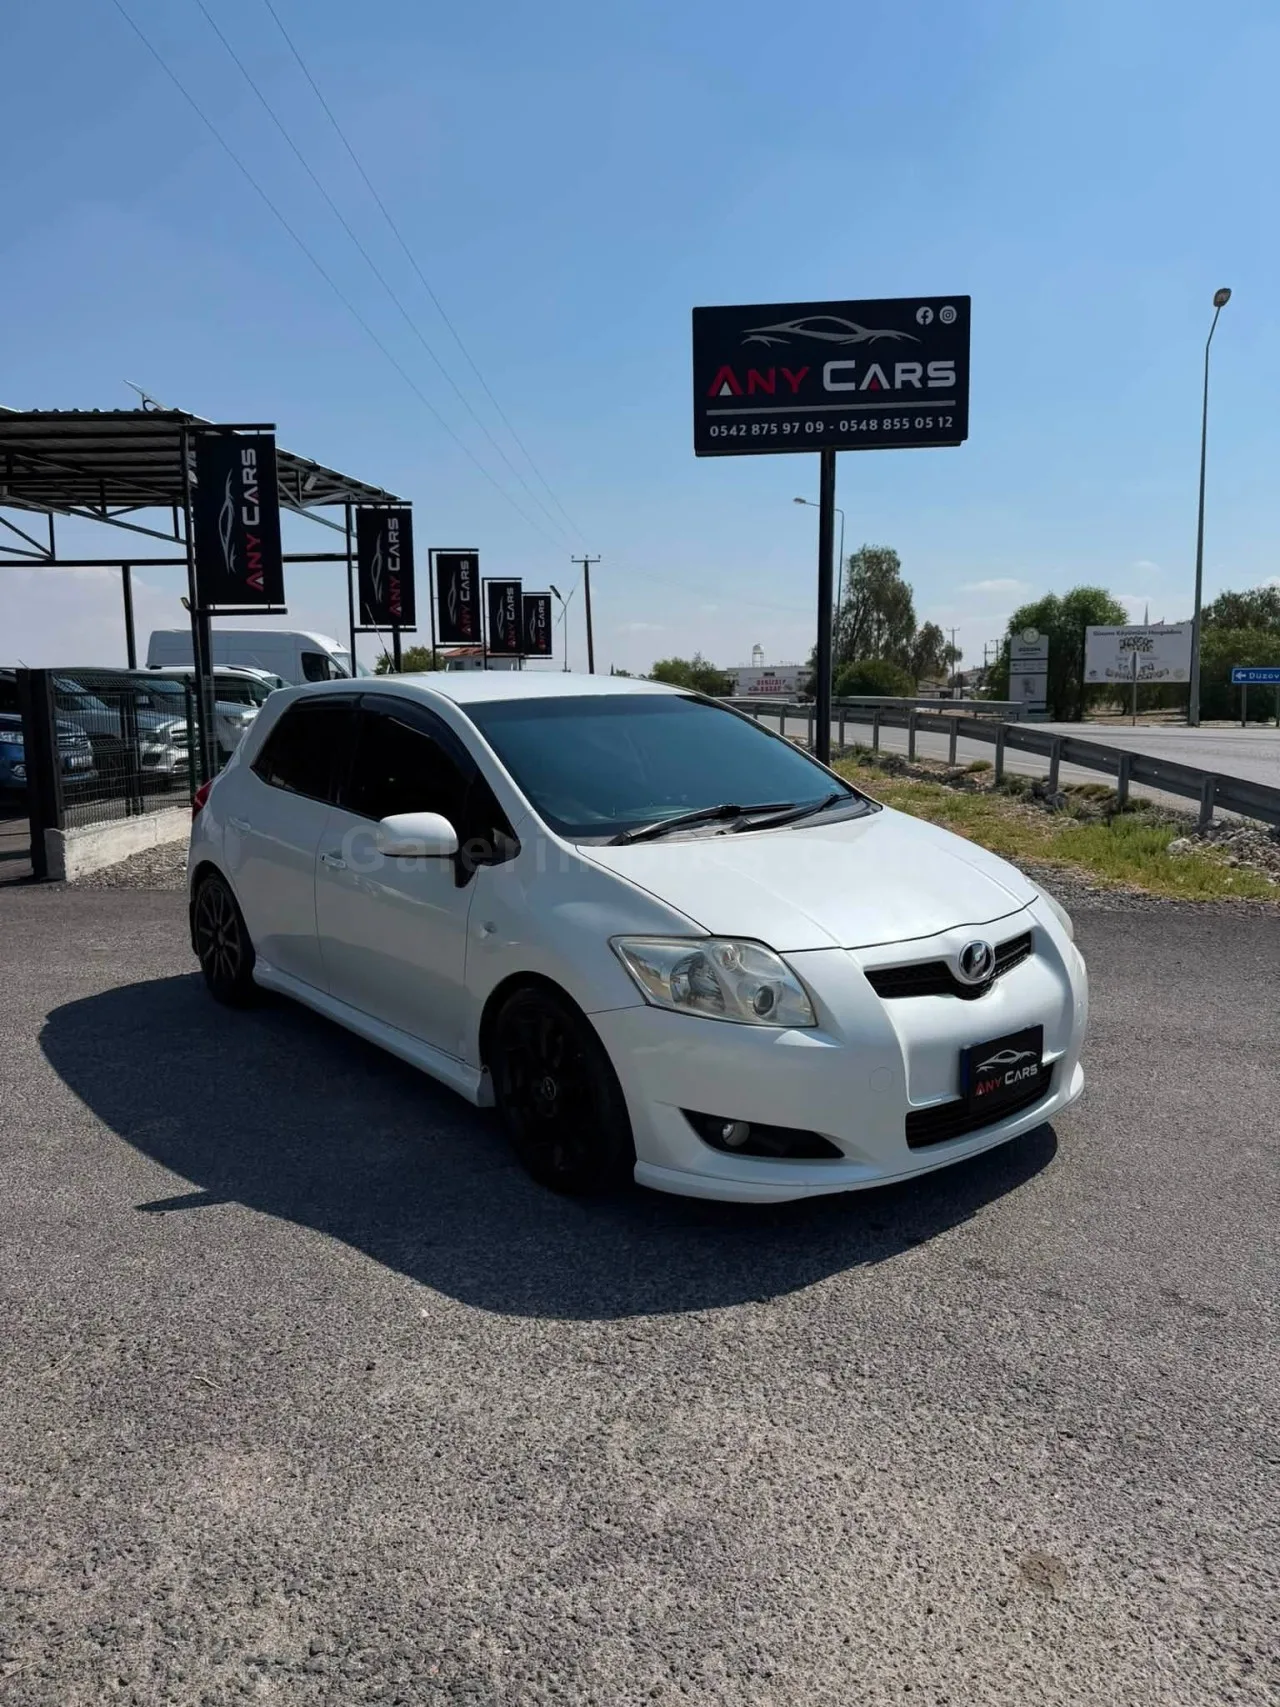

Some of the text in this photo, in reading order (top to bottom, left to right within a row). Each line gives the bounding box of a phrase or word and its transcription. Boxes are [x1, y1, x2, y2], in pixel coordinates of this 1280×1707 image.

[707, 360, 956, 397] ANY CARS
[710, 424, 746, 437] 0542
[751, 423, 778, 435] 875
[783, 422, 800, 434] 97
[805, 421, 824, 433] 09
[840, 419, 878, 432] 0548
[883, 418, 910, 430] 855
[915, 417, 933, 429] 05
[938, 416, 953, 428] 12
[241, 448, 264, 592] ANY CARS
[387, 517, 402, 617] ANY CARS
[460, 560, 472, 636] ANY CARS
[506, 587, 515, 621] CARS
[975, 1064, 1038, 1097] ANY CARS
